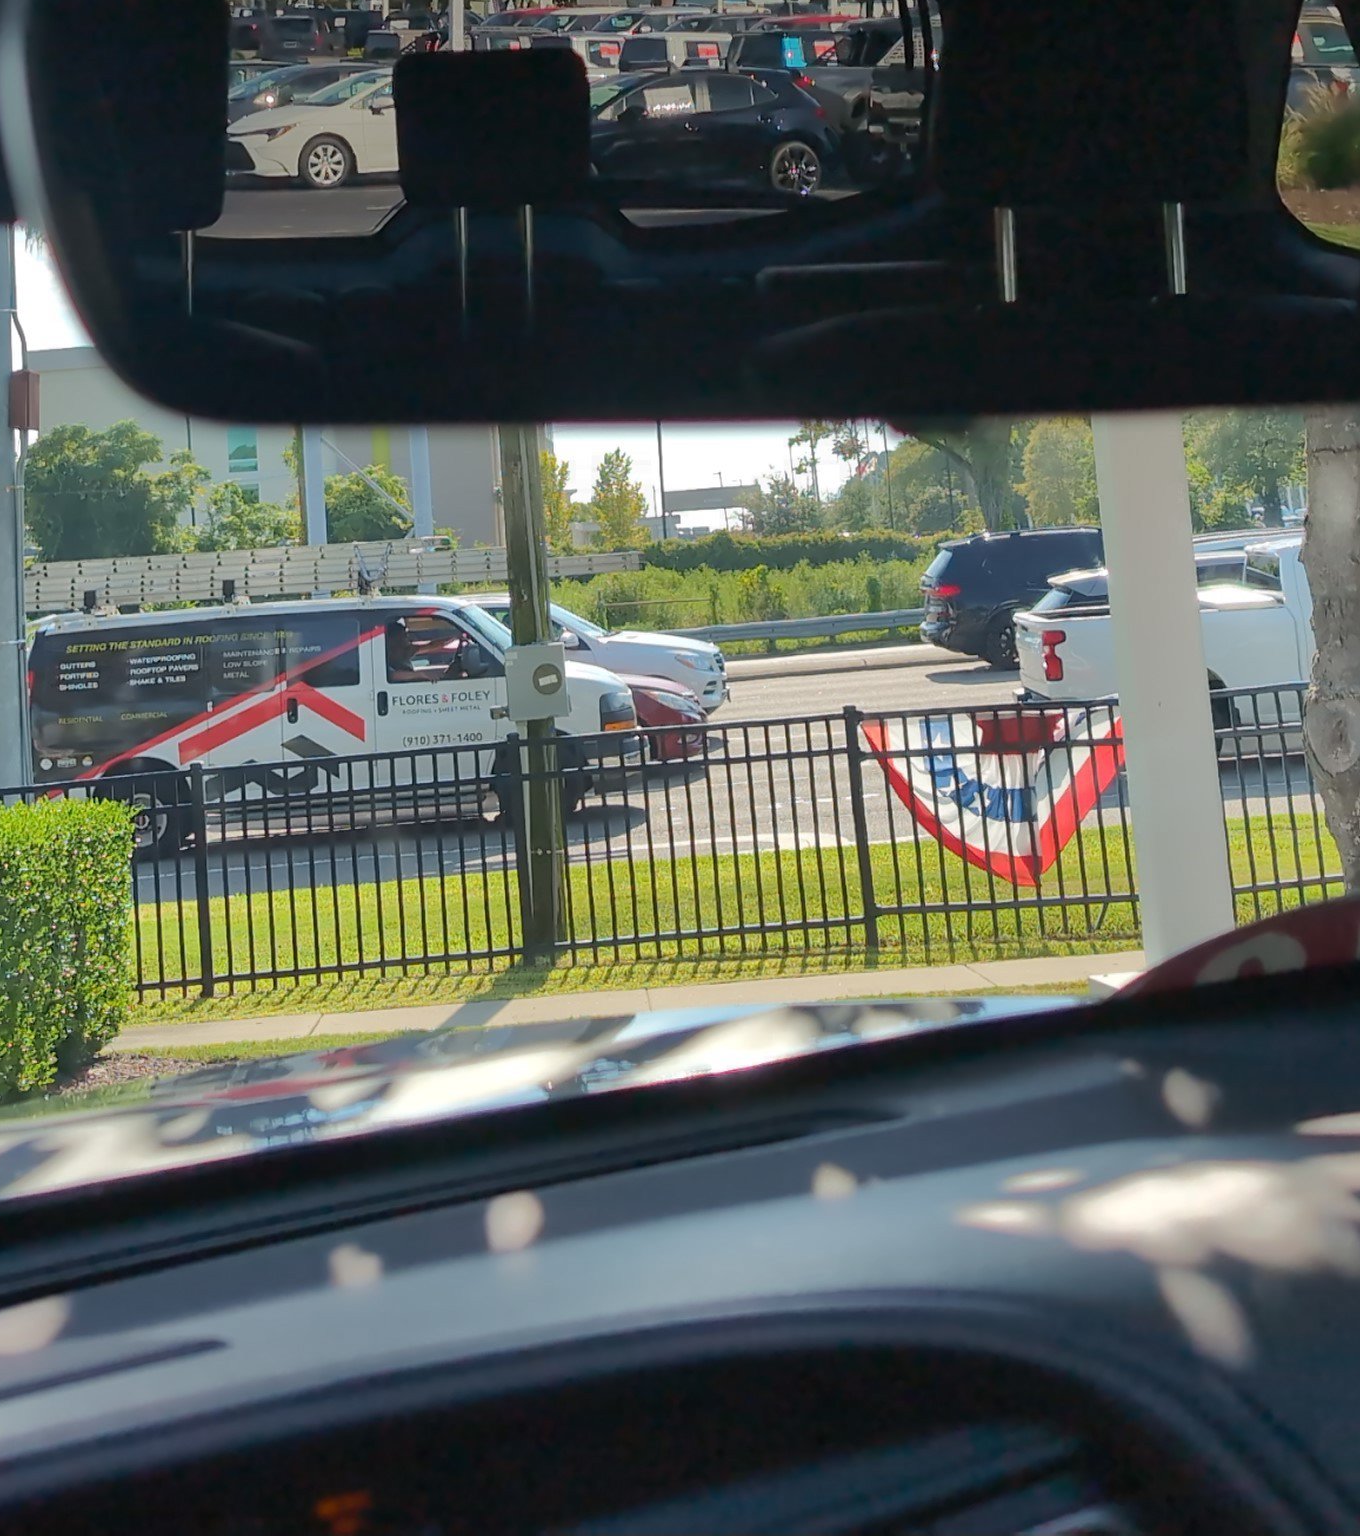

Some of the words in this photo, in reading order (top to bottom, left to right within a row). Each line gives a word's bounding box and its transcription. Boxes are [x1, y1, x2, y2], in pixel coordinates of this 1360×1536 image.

[66, 642, 107, 654] SETTING
[109, 640, 127, 650] THE
[130, 637, 181, 649] STANDARD
[183, 637, 192, 645] IN
[129, 653, 196, 665] WATERPROOFING
[59, 661, 96, 670] GUTTERS
[223, 660, 241, 669] LOW
[130, 667, 167, 676] ROOFTOP
[168, 664, 199, 673] PAVERS
[223, 671, 249, 679] METAL
[59, 671, 99, 681] FORTIFIED
[129, 677, 155, 686] SHAKE
[165, 675, 186, 683] TILES
[59, 682, 98, 691] SHINGLES
[392, 693, 439, 706] FLORES
[441, 694, 449, 703] &
[451, 690, 490, 702] FOLEY
[121, 712, 168, 721] COMMERCIAL
[402, 734, 430, 748] (910)
[433, 732, 483, 744] 371-1400
